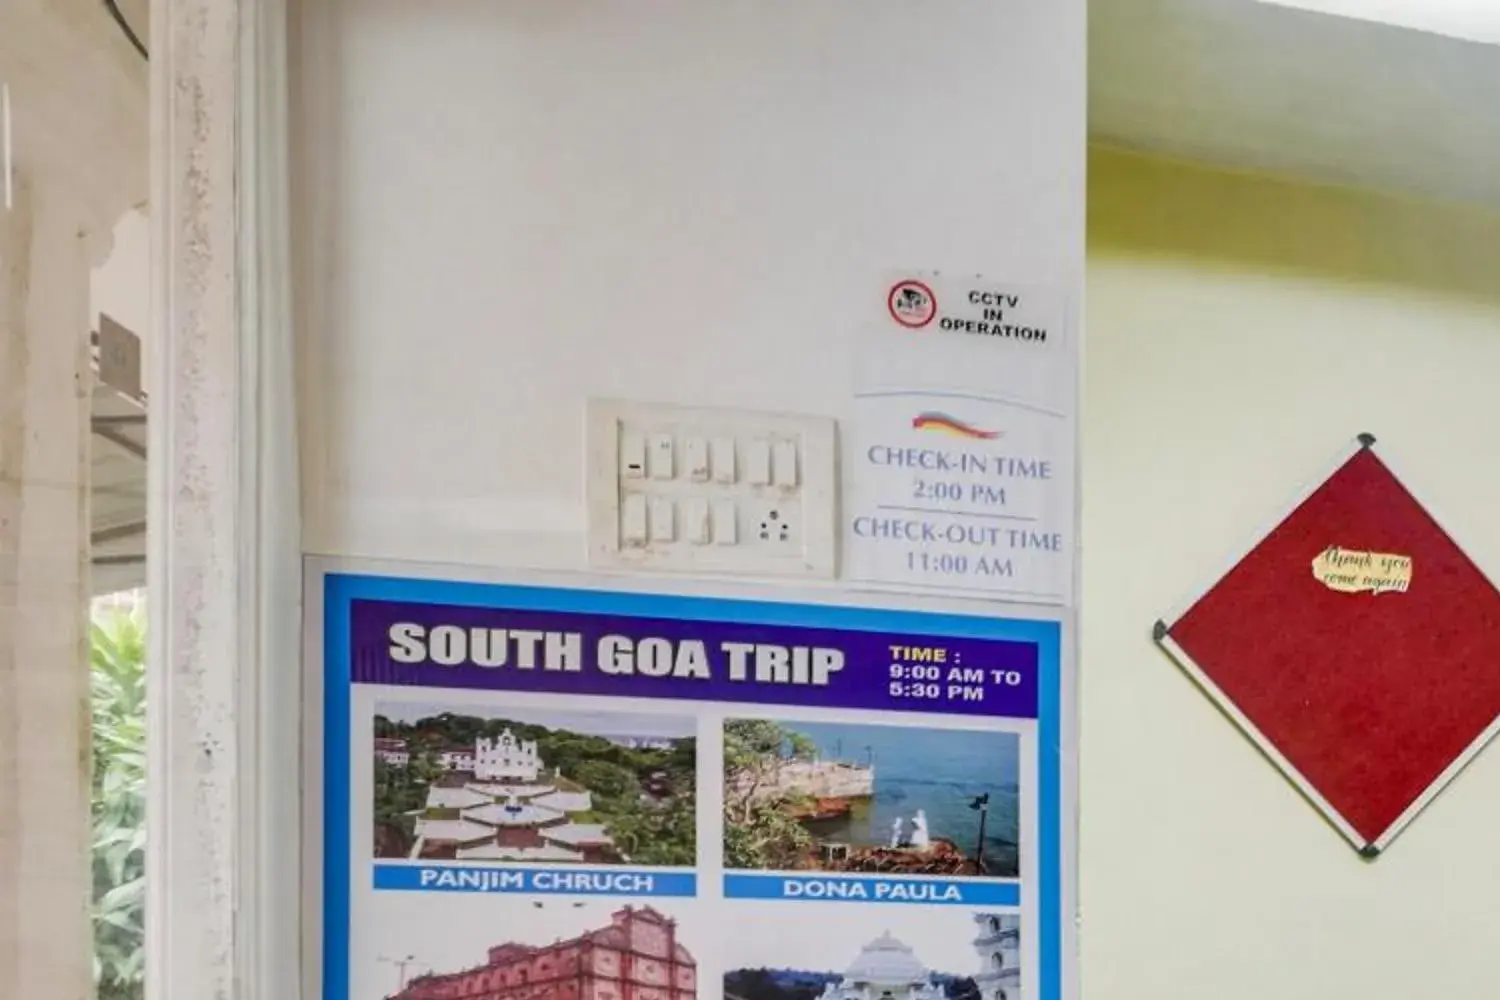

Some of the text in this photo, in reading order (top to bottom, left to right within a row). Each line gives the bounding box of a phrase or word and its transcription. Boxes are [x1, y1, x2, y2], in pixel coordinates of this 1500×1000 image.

[968, 290, 1019, 308] CCTV
[983, 308, 1003, 322] IN
[939, 317, 1048, 342] OPERATION
[867, 445, 1053, 480] CHECK-IN TIME
[912, 478, 1006, 505] 2:00 PM
[853, 516, 1063, 551] CHECK-OUT TIME
[907, 551, 1013, 577] 11:00 AM
[388, 622, 845, 685] SOUTH GOA TRIP
[889, 663, 1022, 686] 9:00 AM TO
[889, 681, 984, 701] 5:30 PM
[420, 868, 654, 893] PANJIM CHRUCH
[784, 878, 963, 901] DONA PAULA
